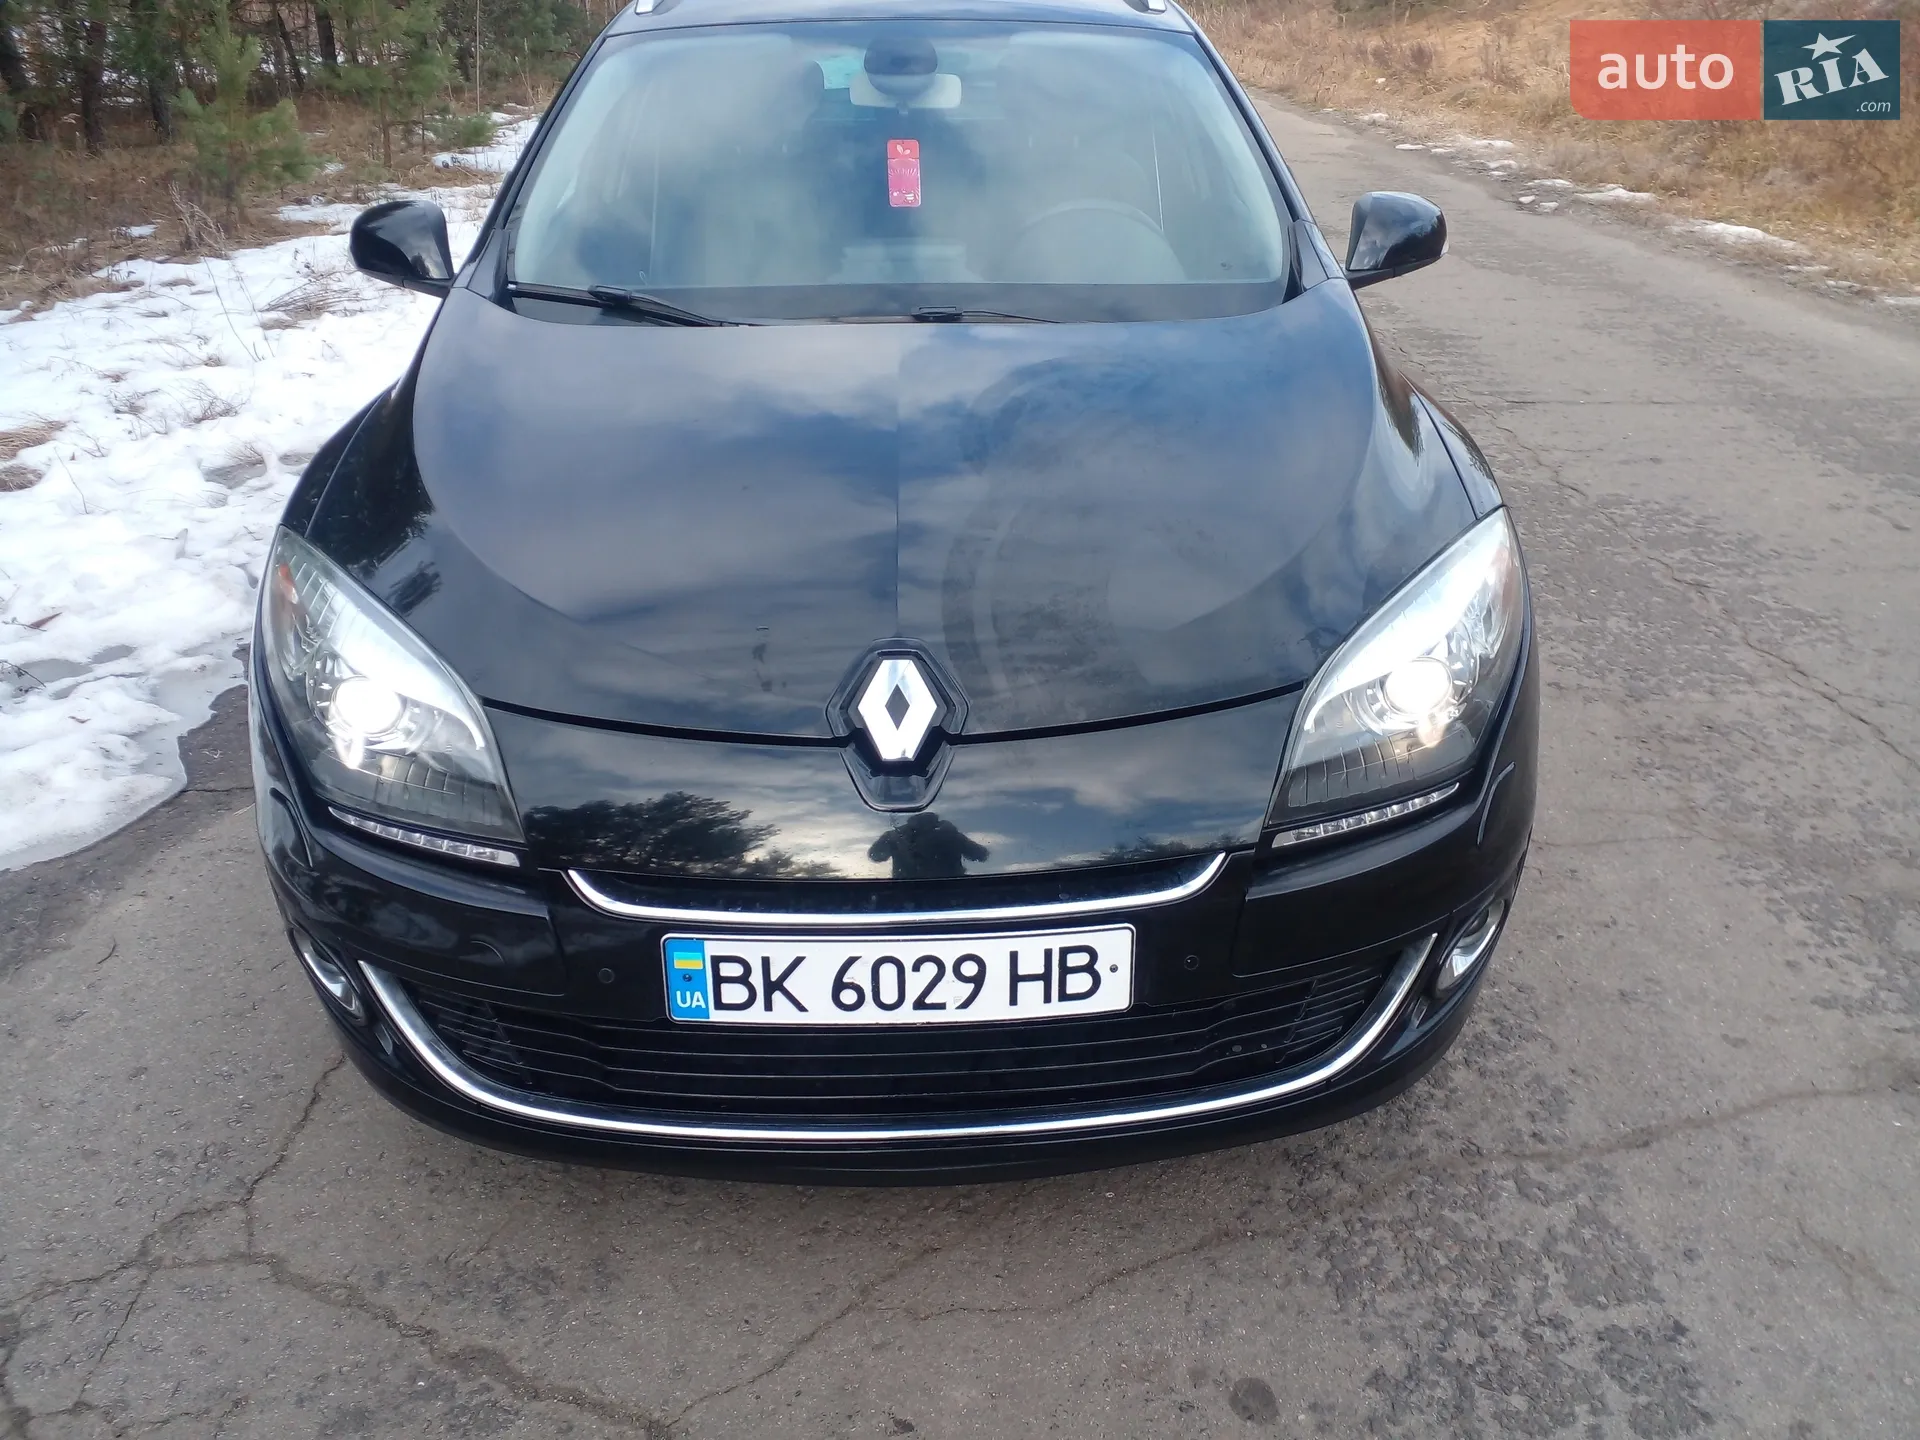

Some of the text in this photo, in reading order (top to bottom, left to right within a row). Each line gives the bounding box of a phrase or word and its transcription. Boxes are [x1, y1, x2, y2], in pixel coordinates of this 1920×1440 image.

[676, 990, 706, 1009] UA
[710, 944, 1102, 1012] BK 6029 HB
